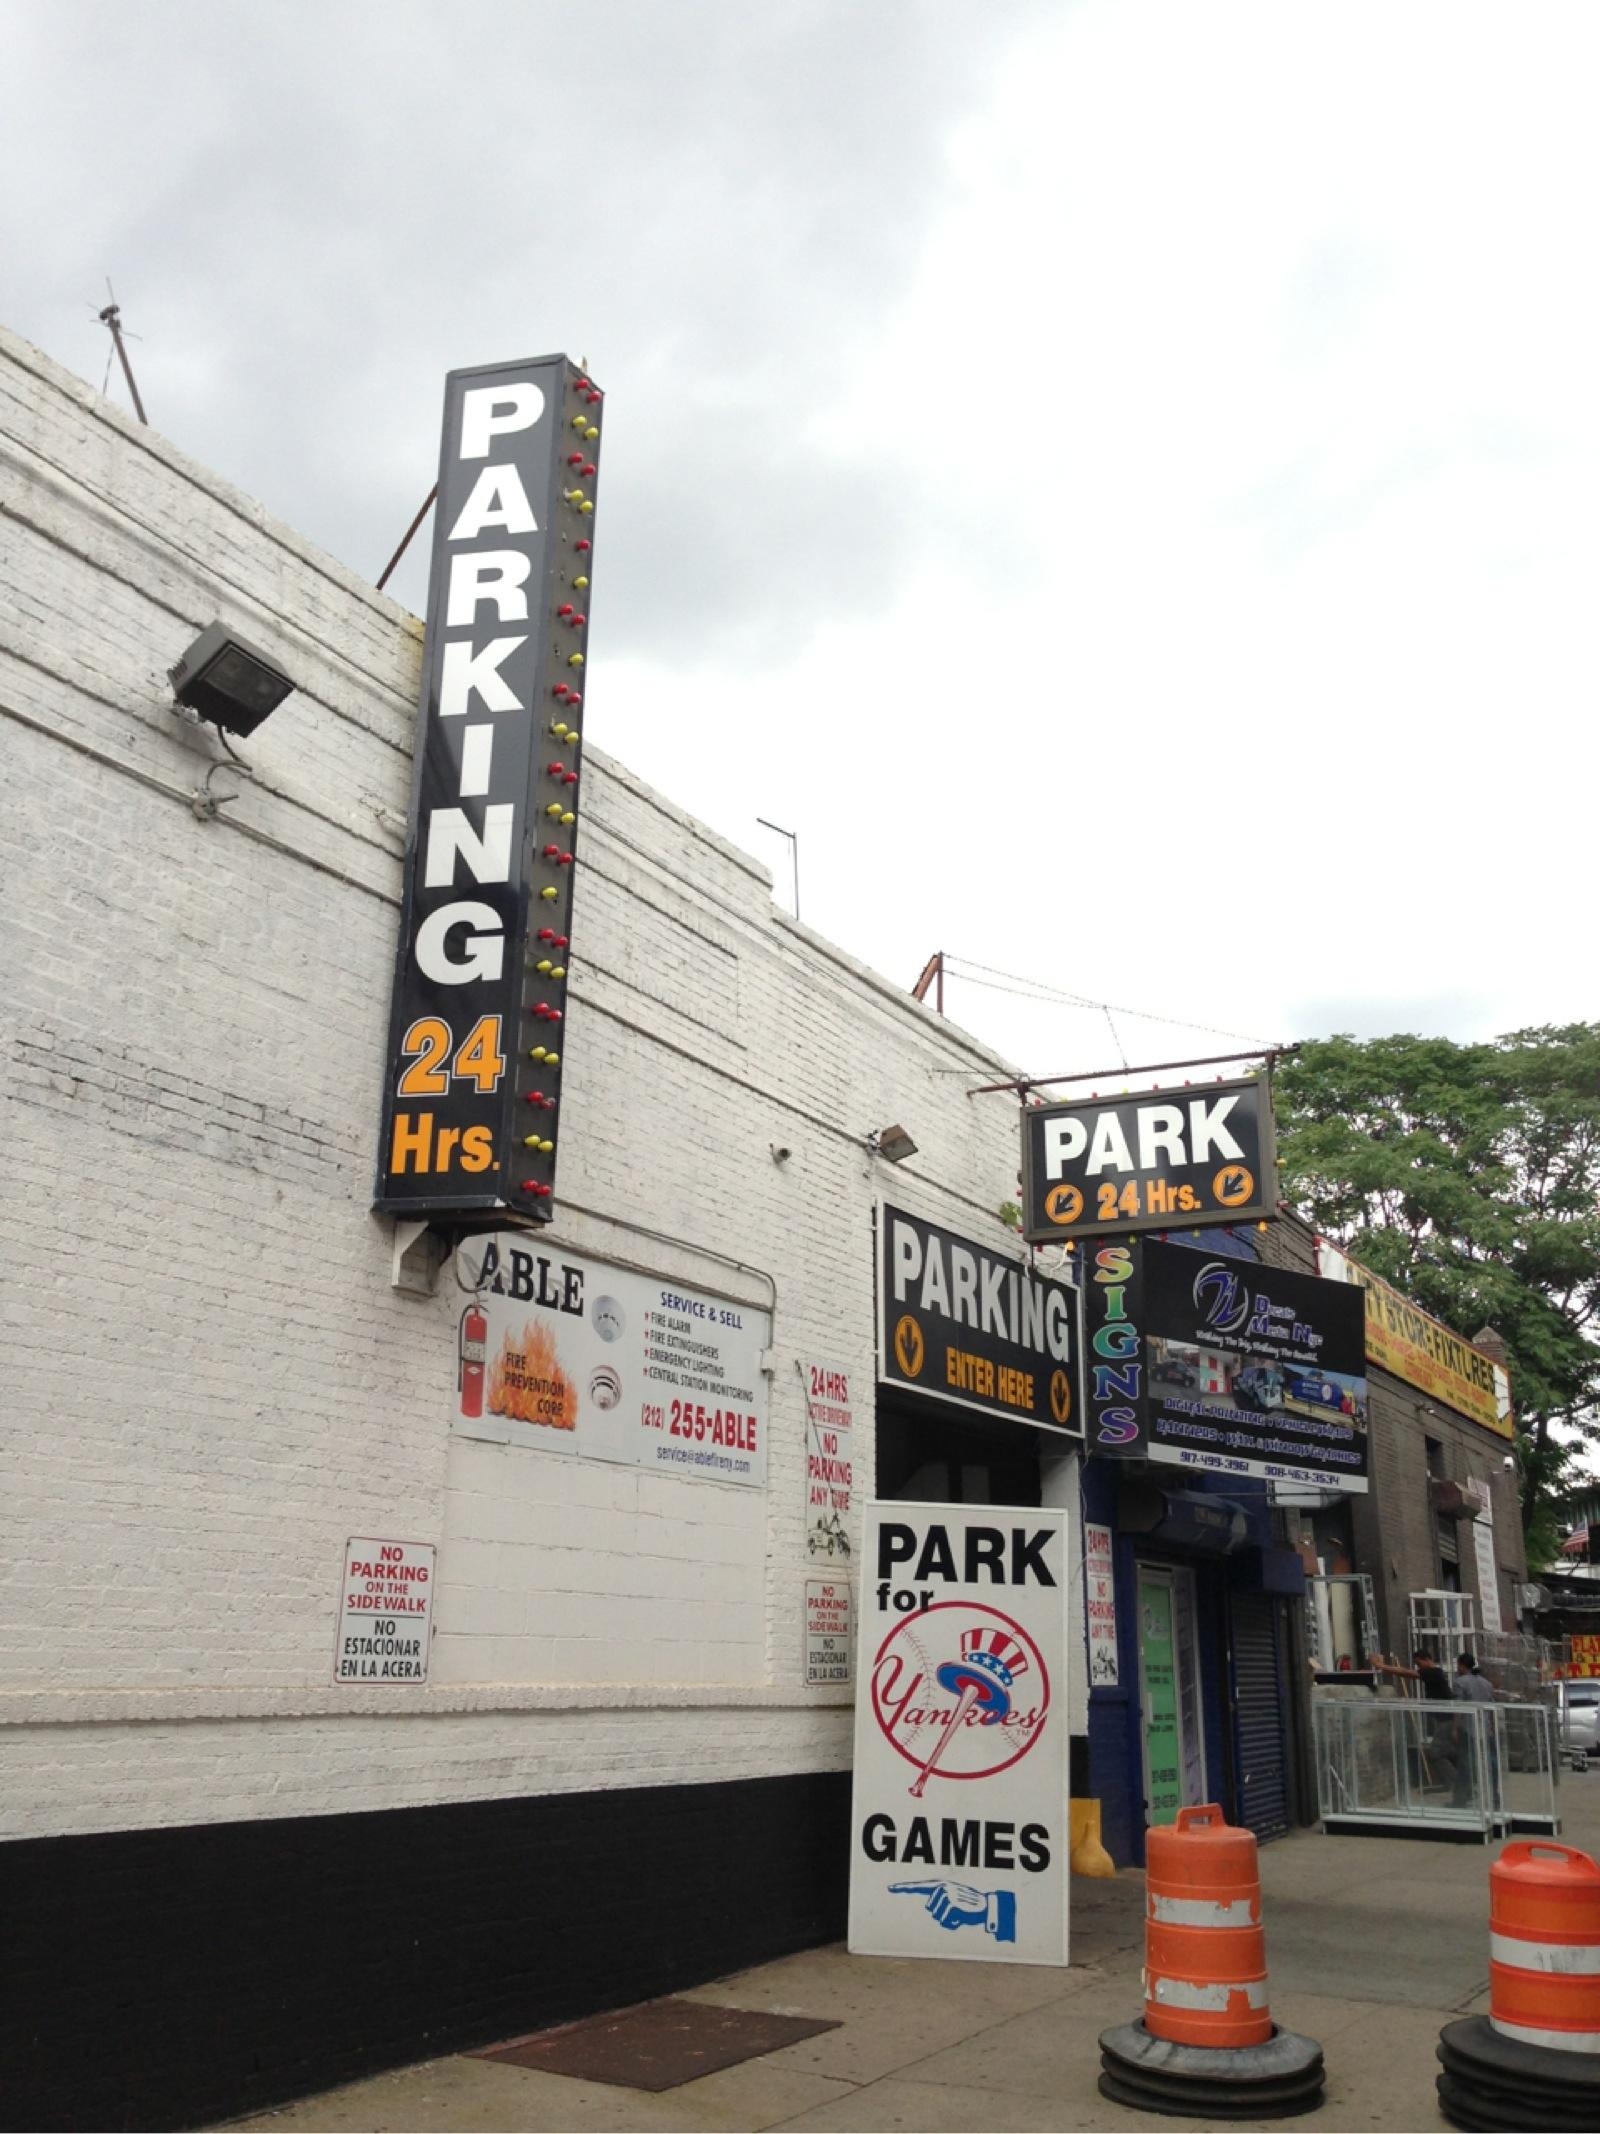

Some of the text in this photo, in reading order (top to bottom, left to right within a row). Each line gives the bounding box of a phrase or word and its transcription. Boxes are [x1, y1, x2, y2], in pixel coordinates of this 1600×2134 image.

[413, 382, 545, 986] PARKING
[397, 1015, 506, 1097] 24
[391, 1112, 501, 1174] Hrs.
[1044, 1095, 1246, 1180] PARK
[1097, 1177, 1202, 1221] 24 Hrs.
[475, 1242, 584, 1317] ABLE
[893, 1219, 1070, 1363] PARKING
[651, 1311, 691, 1334] FIRE ALARM
[661, 1291, 743, 1330] SERVICE & SELL
[650, 1329, 665, 1345] FIRE
[1092, 1247, 1142, 1444] SIGNS
[506, 1352, 527, 1369] FIRE
[649, 1347, 724, 1379] EMERGENCY LIGHTING
[1432, 1328, 1496, 1396] FIXTURES
[504, 1372, 565, 1398] PREVENTION
[649, 1366, 754, 1402] CENTRAL STATION MONITORING
[810, 1366, 848, 1403] 24 HRS.
[946, 1346, 1035, 1410] ENTER HERE
[669, 1398, 757, 1452] 255-ABLE
[823, 1433, 838, 1456] NO
[808, 1455, 852, 1485] PARKING
[810, 1486, 828, 1506] ANY
[380, 1546, 403, 1562] NO
[877, 1522, 1058, 1588] PARK
[351, 1561, 429, 1582] PARKING
[347, 1594, 426, 1612] SIDEWALK
[366, 1581, 409, 1595] ON THE
[822, 1586, 834, 1597] NO
[876, 1582, 934, 1613] for
[808, 1598, 848, 1611] PARKING
[374, 1620, 396, 1636] NO
[808, 1621, 848, 1632] SIDEWALK
[344, 1637, 421, 1657] ESTACIONAR
[823, 1638, 834, 1650] NO
[341, 1659, 422, 1678] EN LA ACERA
[874, 1655, 1043, 1734] Yankees
[861, 1813, 1051, 1872] GAMES
